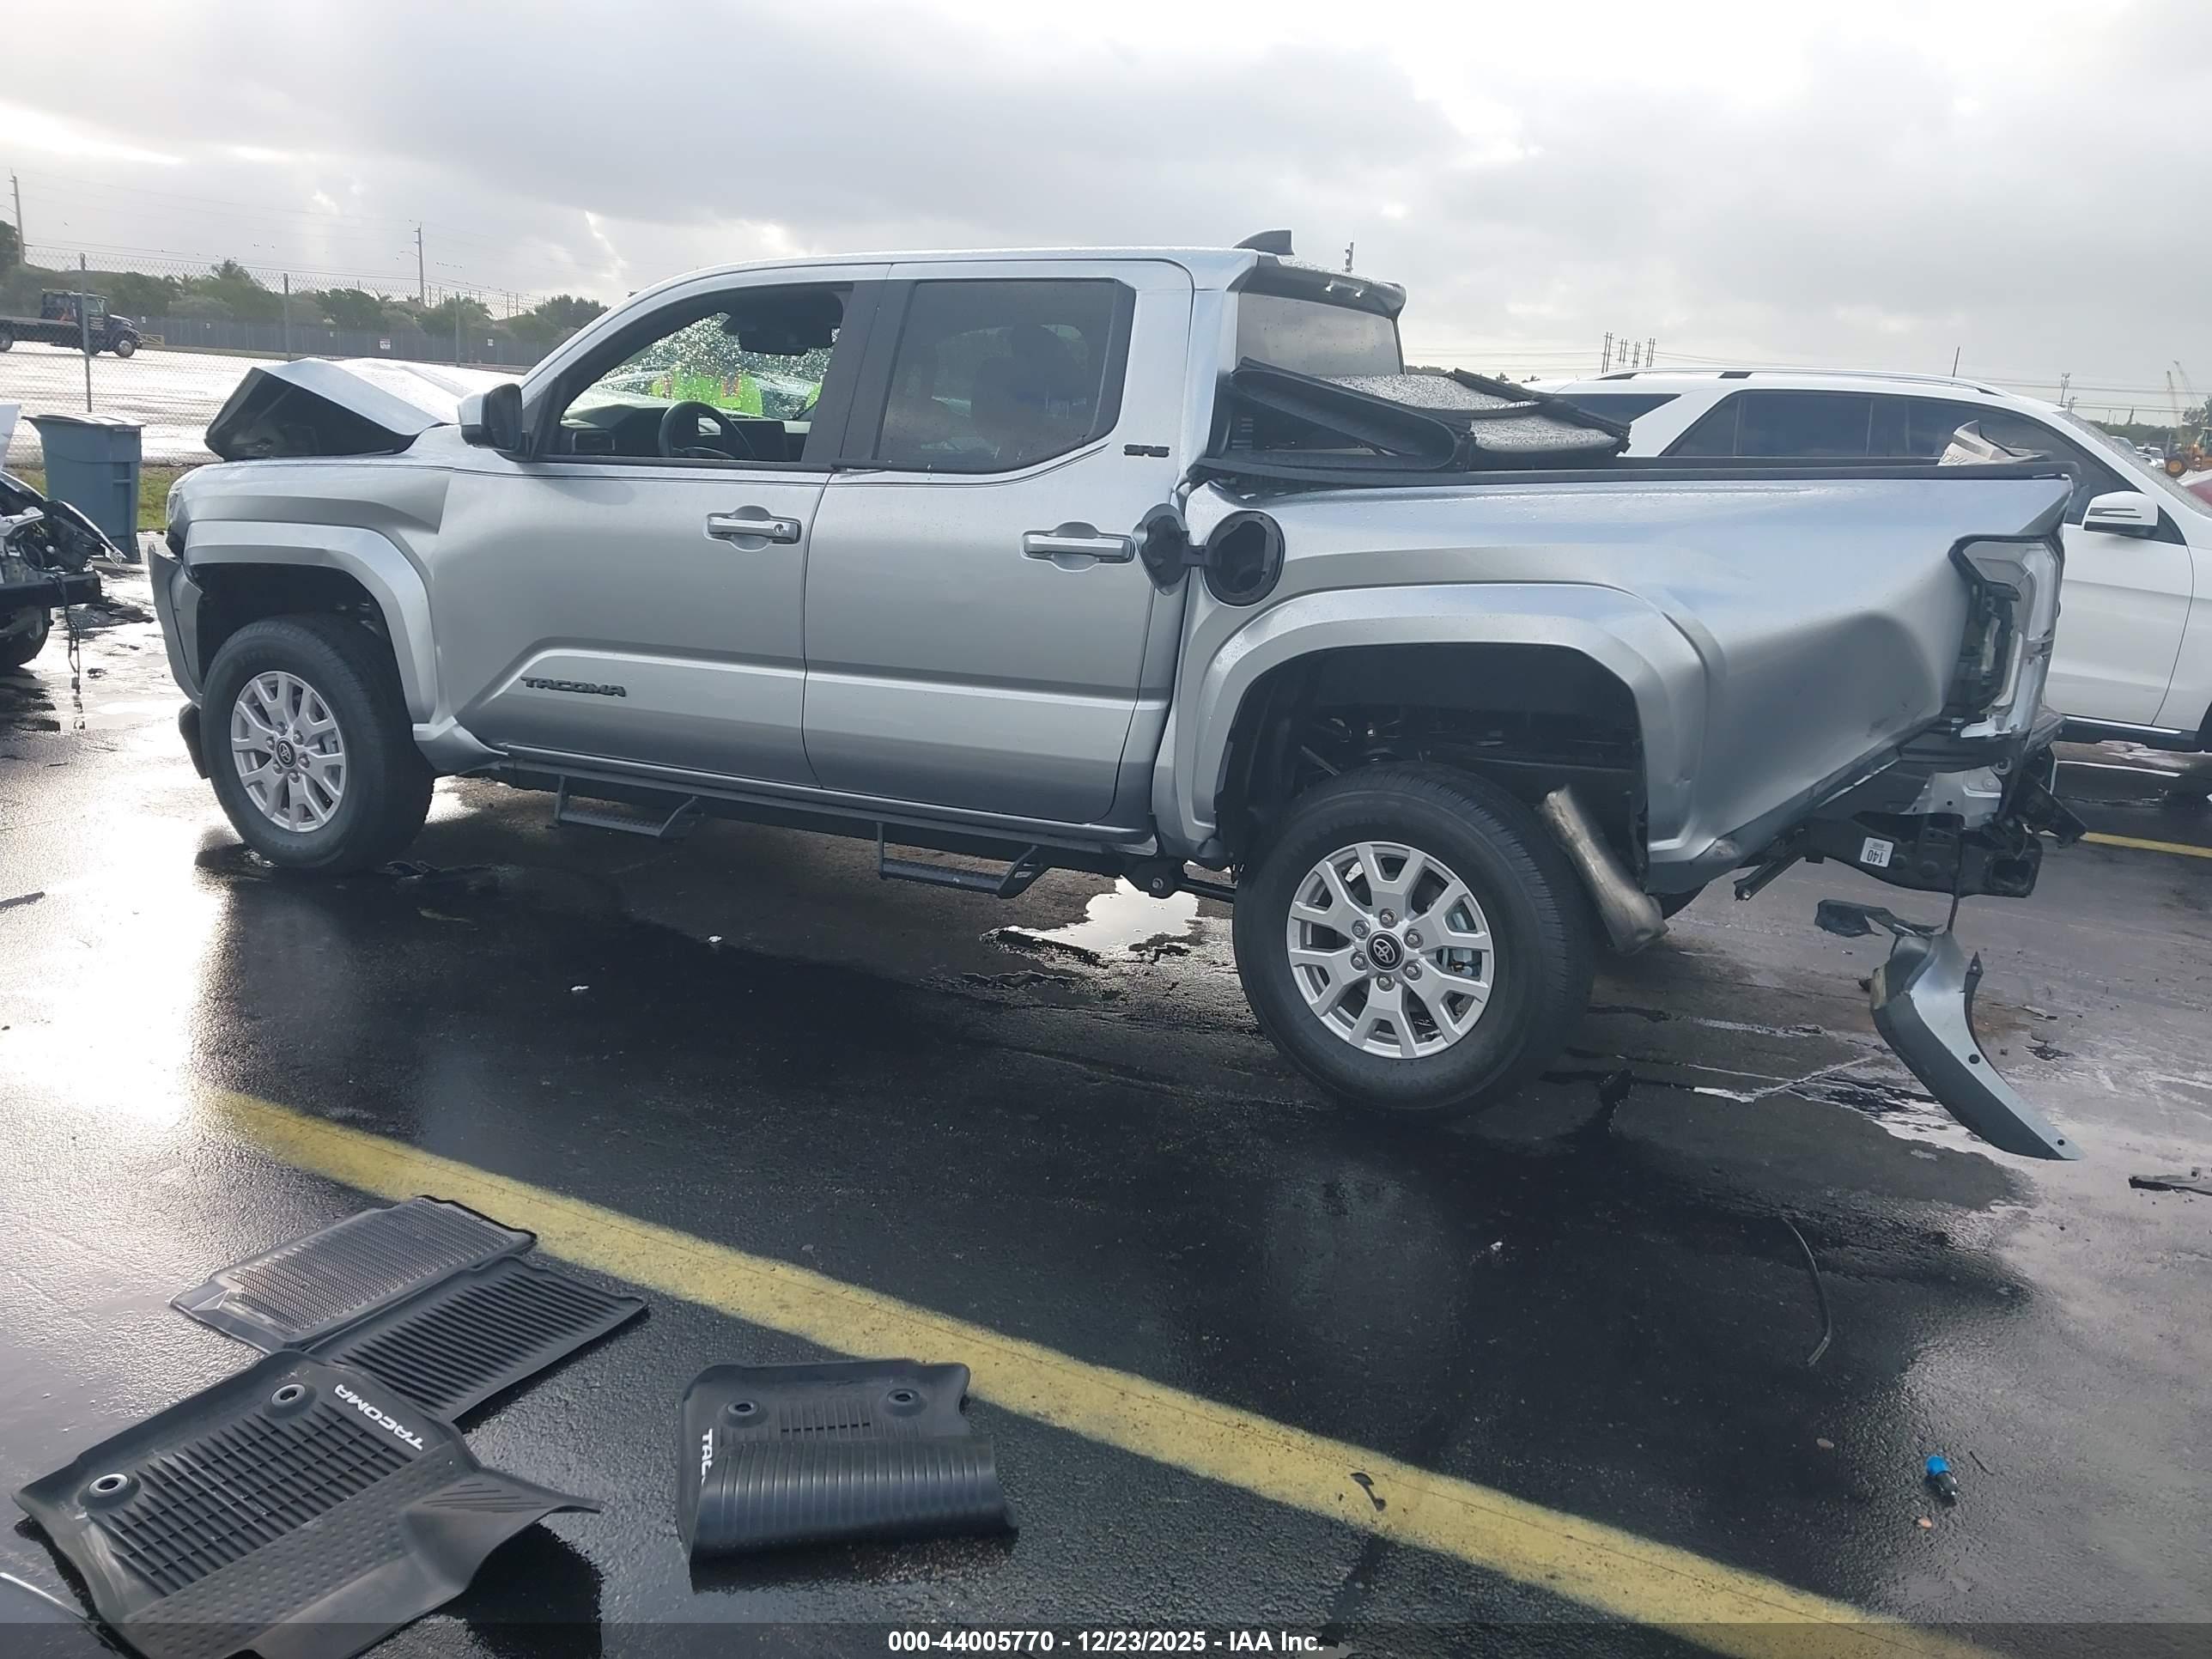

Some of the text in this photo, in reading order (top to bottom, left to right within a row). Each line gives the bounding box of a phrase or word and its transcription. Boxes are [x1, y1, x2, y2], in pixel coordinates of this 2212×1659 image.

[520, 676, 626, 697] TACOMA
[1867, 849, 1884, 864] 140
[334, 1383, 423, 1451] TACOMA
[701, 1428, 713, 1486] TAC
